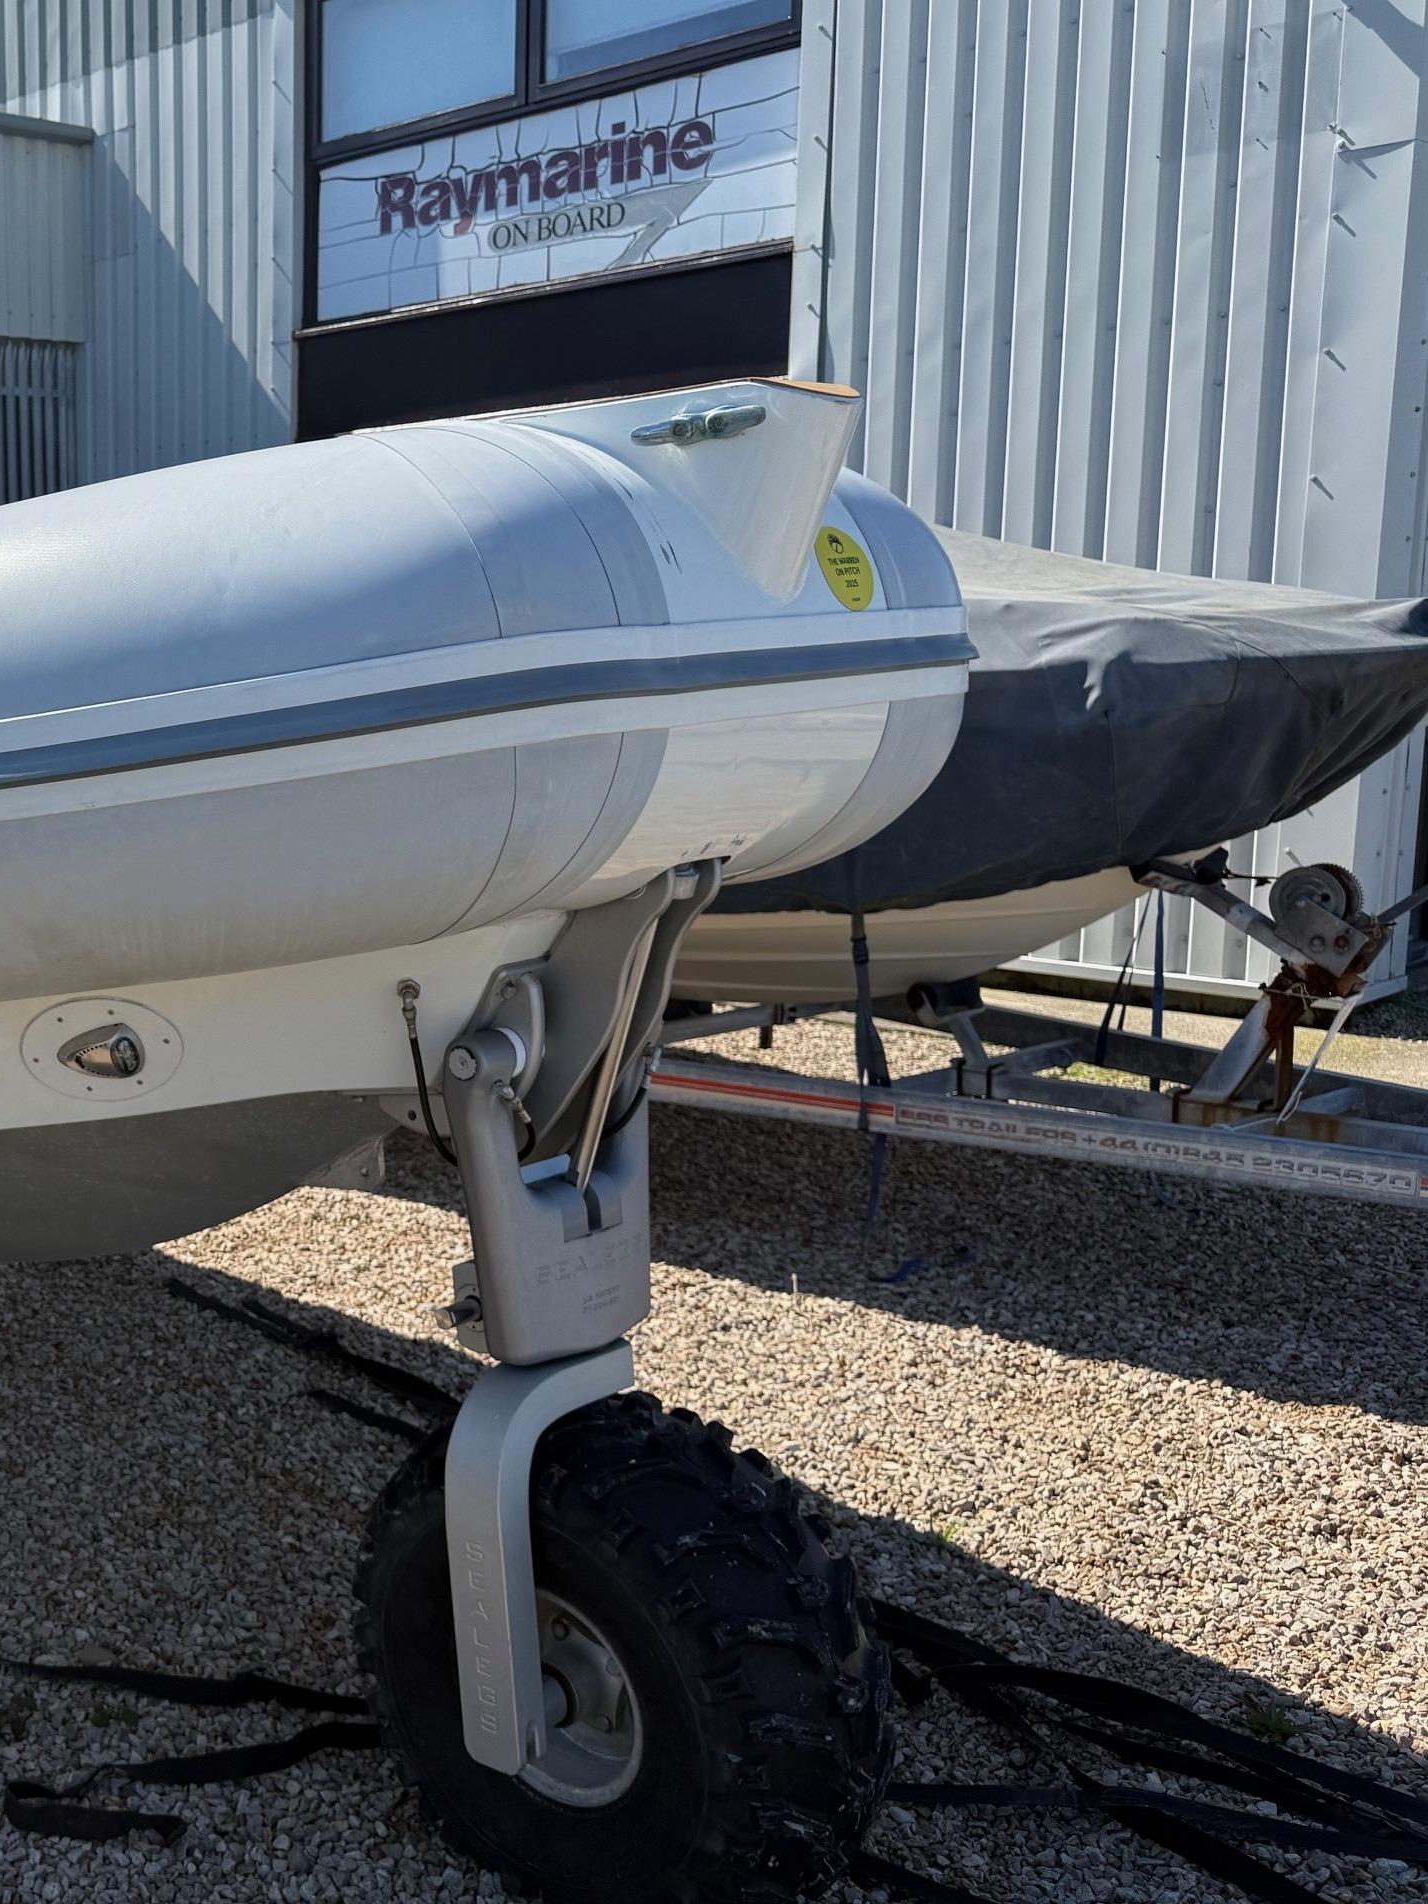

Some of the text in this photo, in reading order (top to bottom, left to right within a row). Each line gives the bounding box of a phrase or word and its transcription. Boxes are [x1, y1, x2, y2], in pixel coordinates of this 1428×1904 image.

[380, 120, 714, 236] Raymarine
[492, 203, 625, 251] ON BOARD
[828, 557, 860, 566] THE WARREN
[835, 566, 860, 576] ON PITCH
[466, 1542, 498, 1735] SEALEGS
